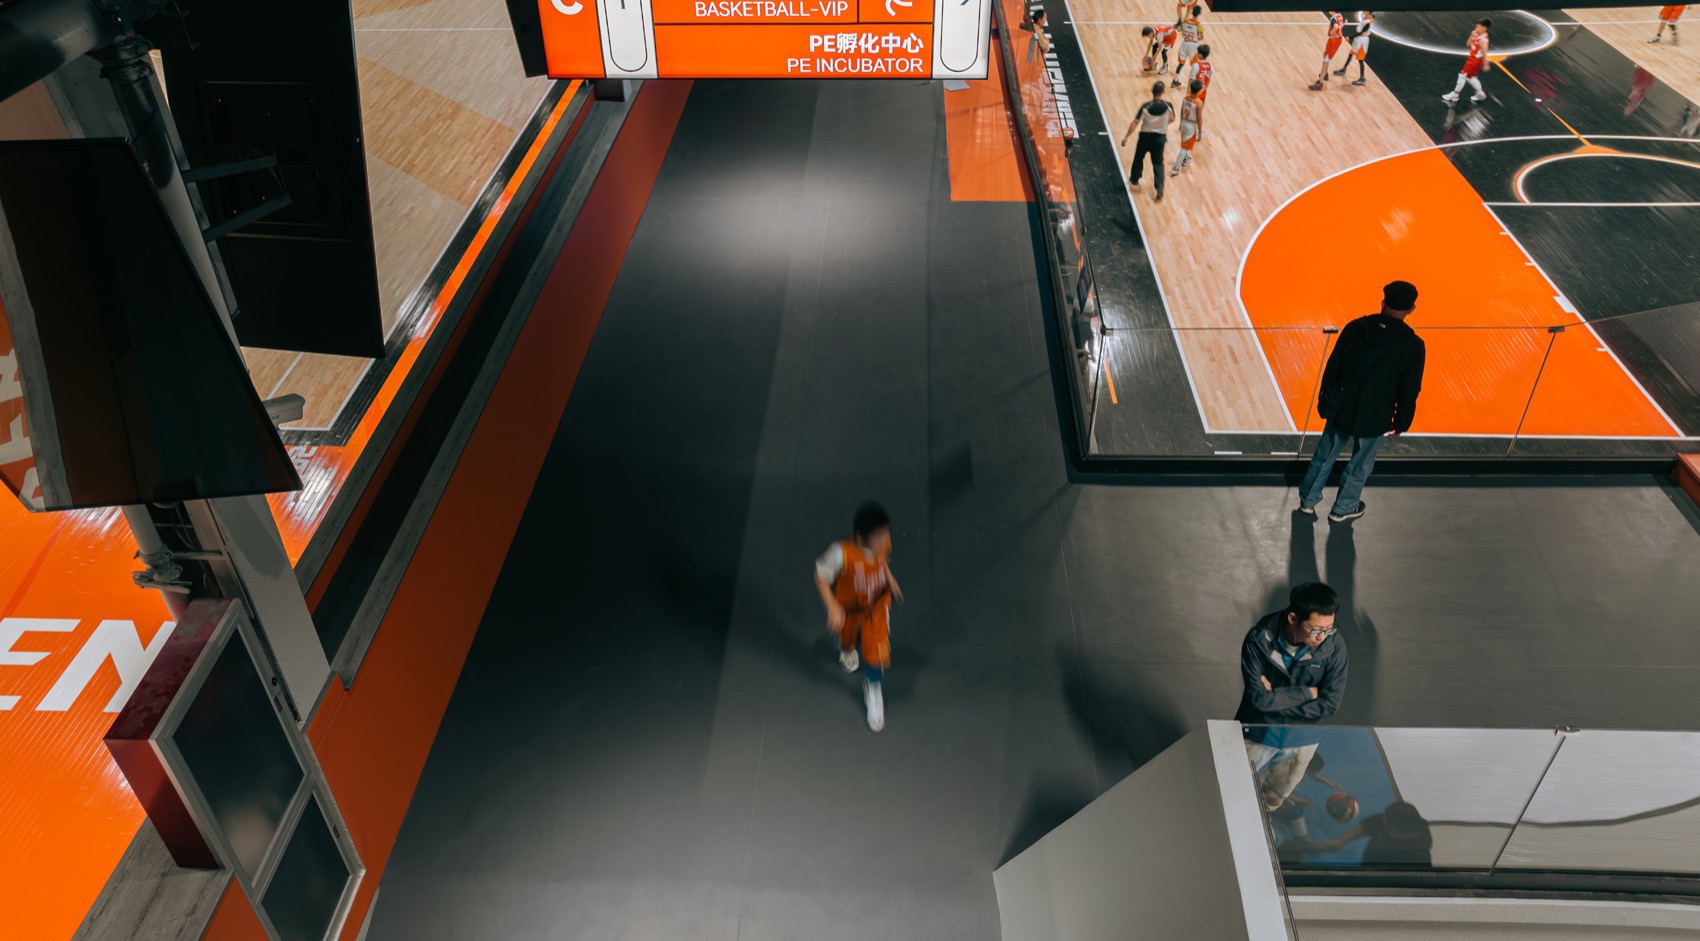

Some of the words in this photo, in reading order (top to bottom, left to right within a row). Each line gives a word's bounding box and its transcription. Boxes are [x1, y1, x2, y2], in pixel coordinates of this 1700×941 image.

[694, 0, 849, 17] BASKETBALL-VIP
[809, 32, 925, 54] PE孵化中心
[787, 57, 812, 73] PE
[815, 57, 924, 73] INCUBATOR
